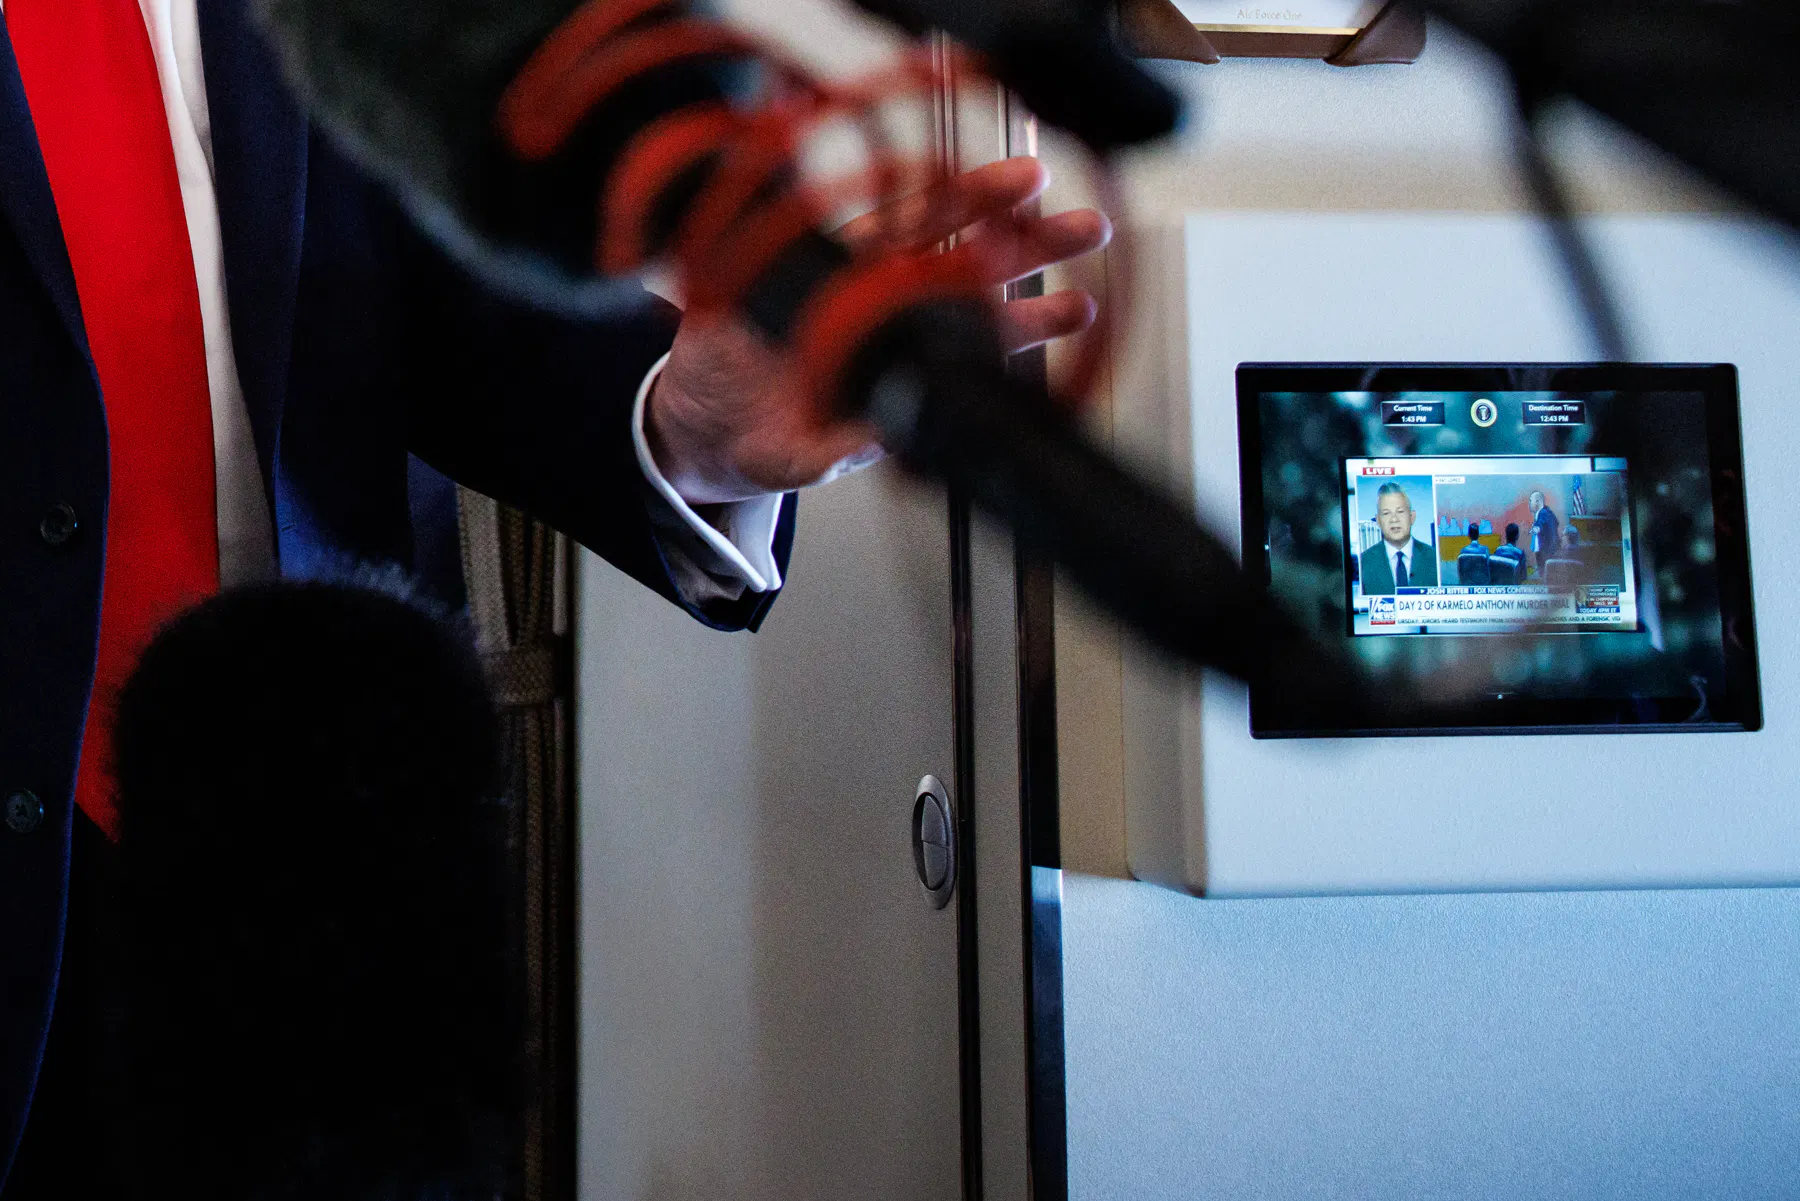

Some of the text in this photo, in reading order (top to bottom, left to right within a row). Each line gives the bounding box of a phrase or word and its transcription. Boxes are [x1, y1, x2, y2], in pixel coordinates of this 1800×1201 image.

[1236, 8, 1302, 20] Air Force One
[1393, 404, 1433, 412] Current Time
[1401, 415, 1415, 423] 1:43
[1376, 603, 1394, 612] FOX
[1399, 600, 1415, 610] DAY
[1417, 600, 1422, 610] 2
[1424, 600, 1435, 610] OF
[1436, 600, 1474, 610] KARMELO
[1475, 600, 1515, 610] ANTHONY
[1517, 599, 1549, 609] MURDER
[1373, 612, 1396, 620] NEWS
